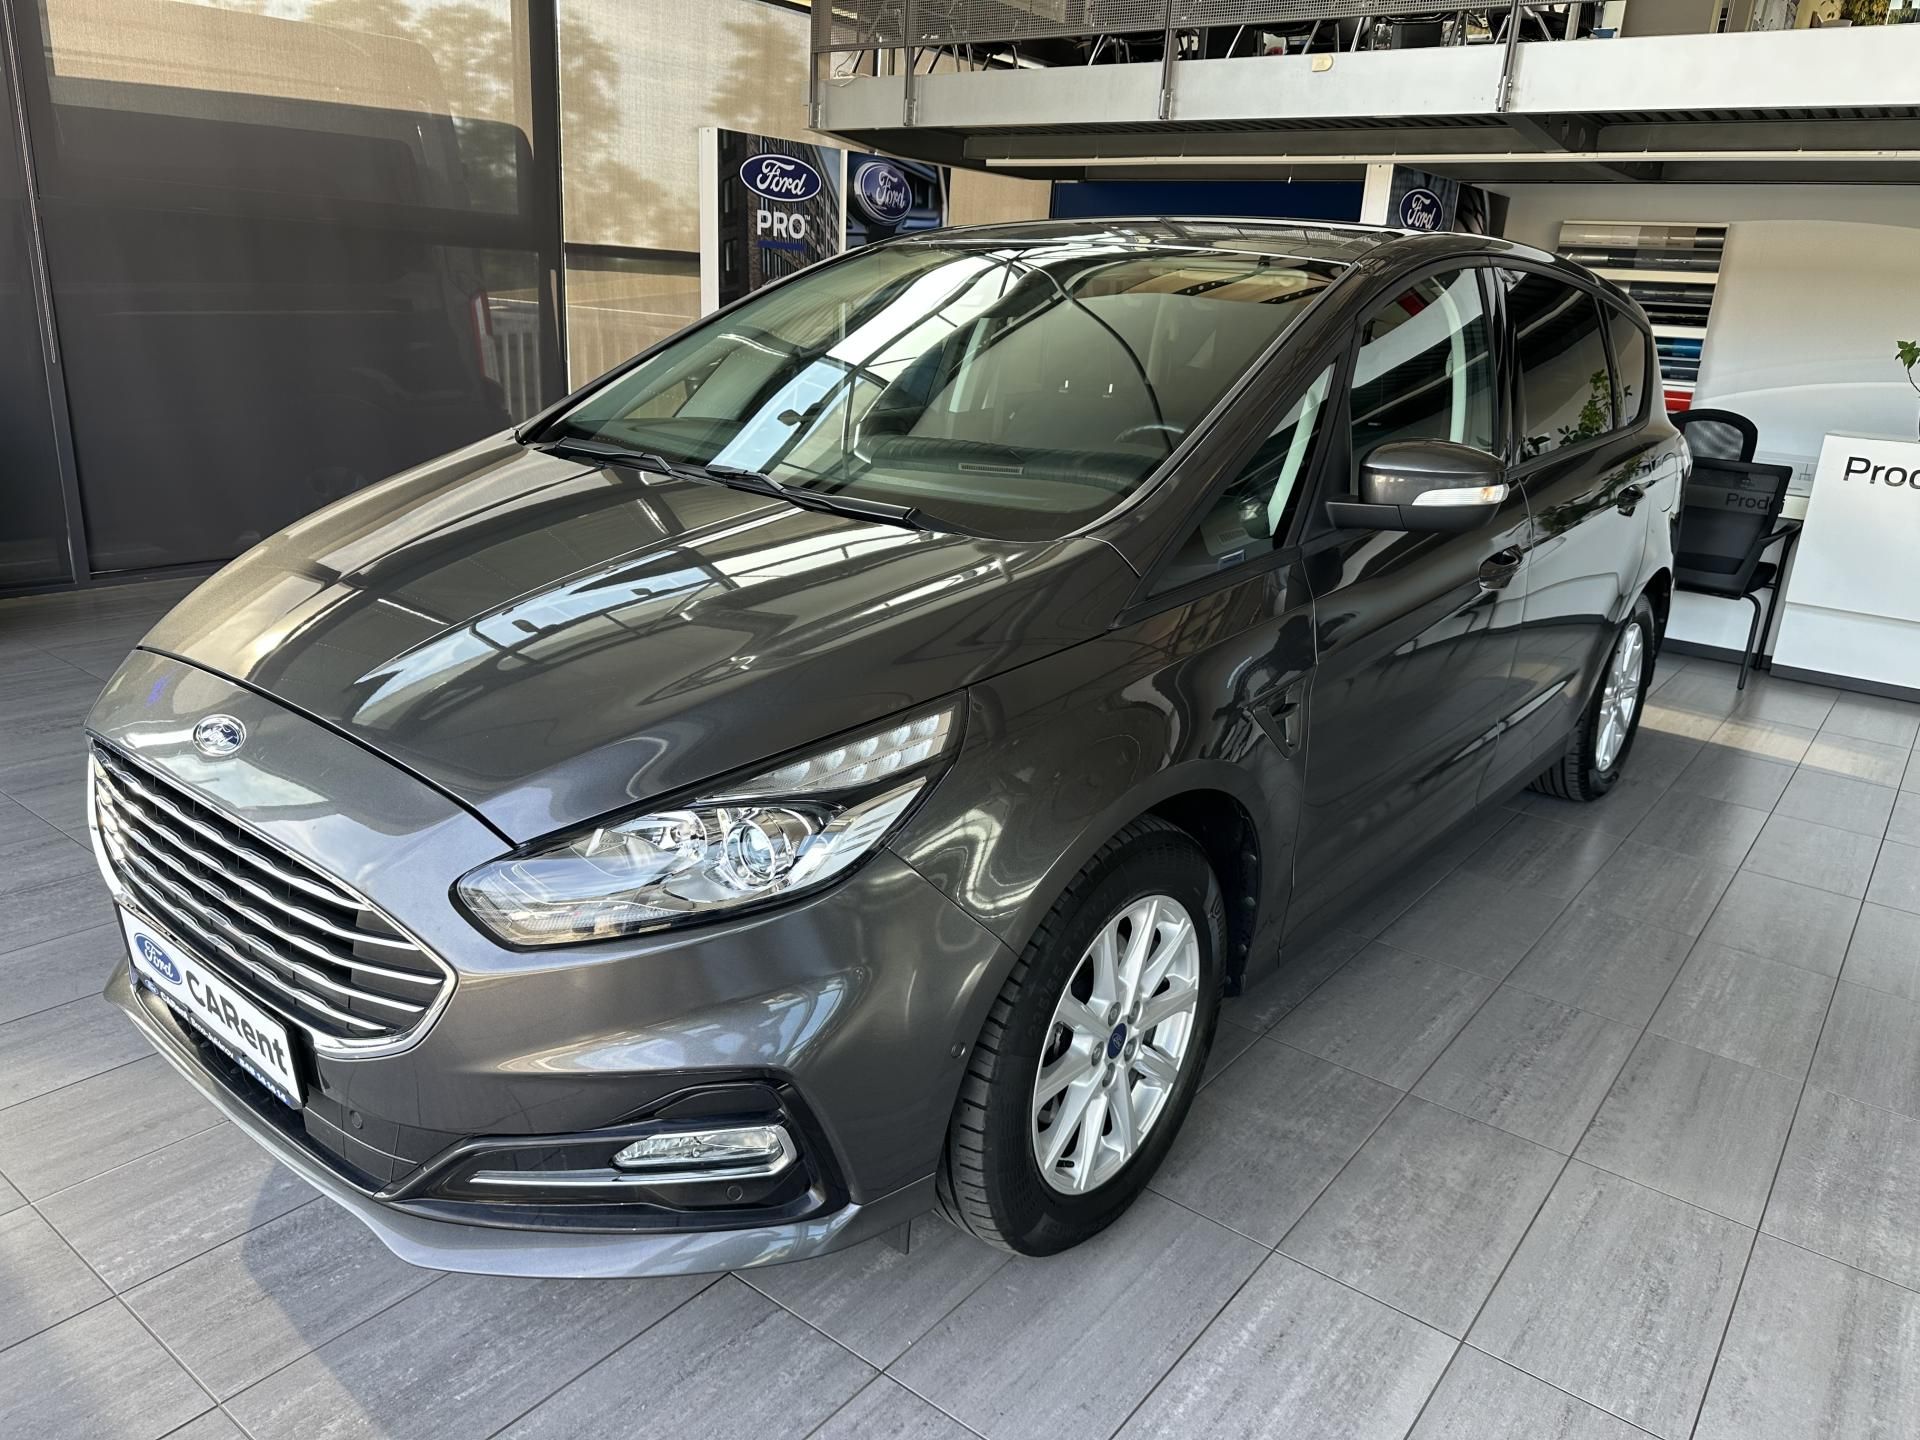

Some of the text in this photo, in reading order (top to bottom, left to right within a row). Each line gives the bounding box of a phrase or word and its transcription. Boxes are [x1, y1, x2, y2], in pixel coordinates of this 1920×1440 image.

[756, 159, 807, 195] Ford
[876, 171, 906, 209] Ford
[1406, 194, 1437, 229] Ford
[144, 939, 174, 978] Ford
[185, 970, 288, 1077] CARent
